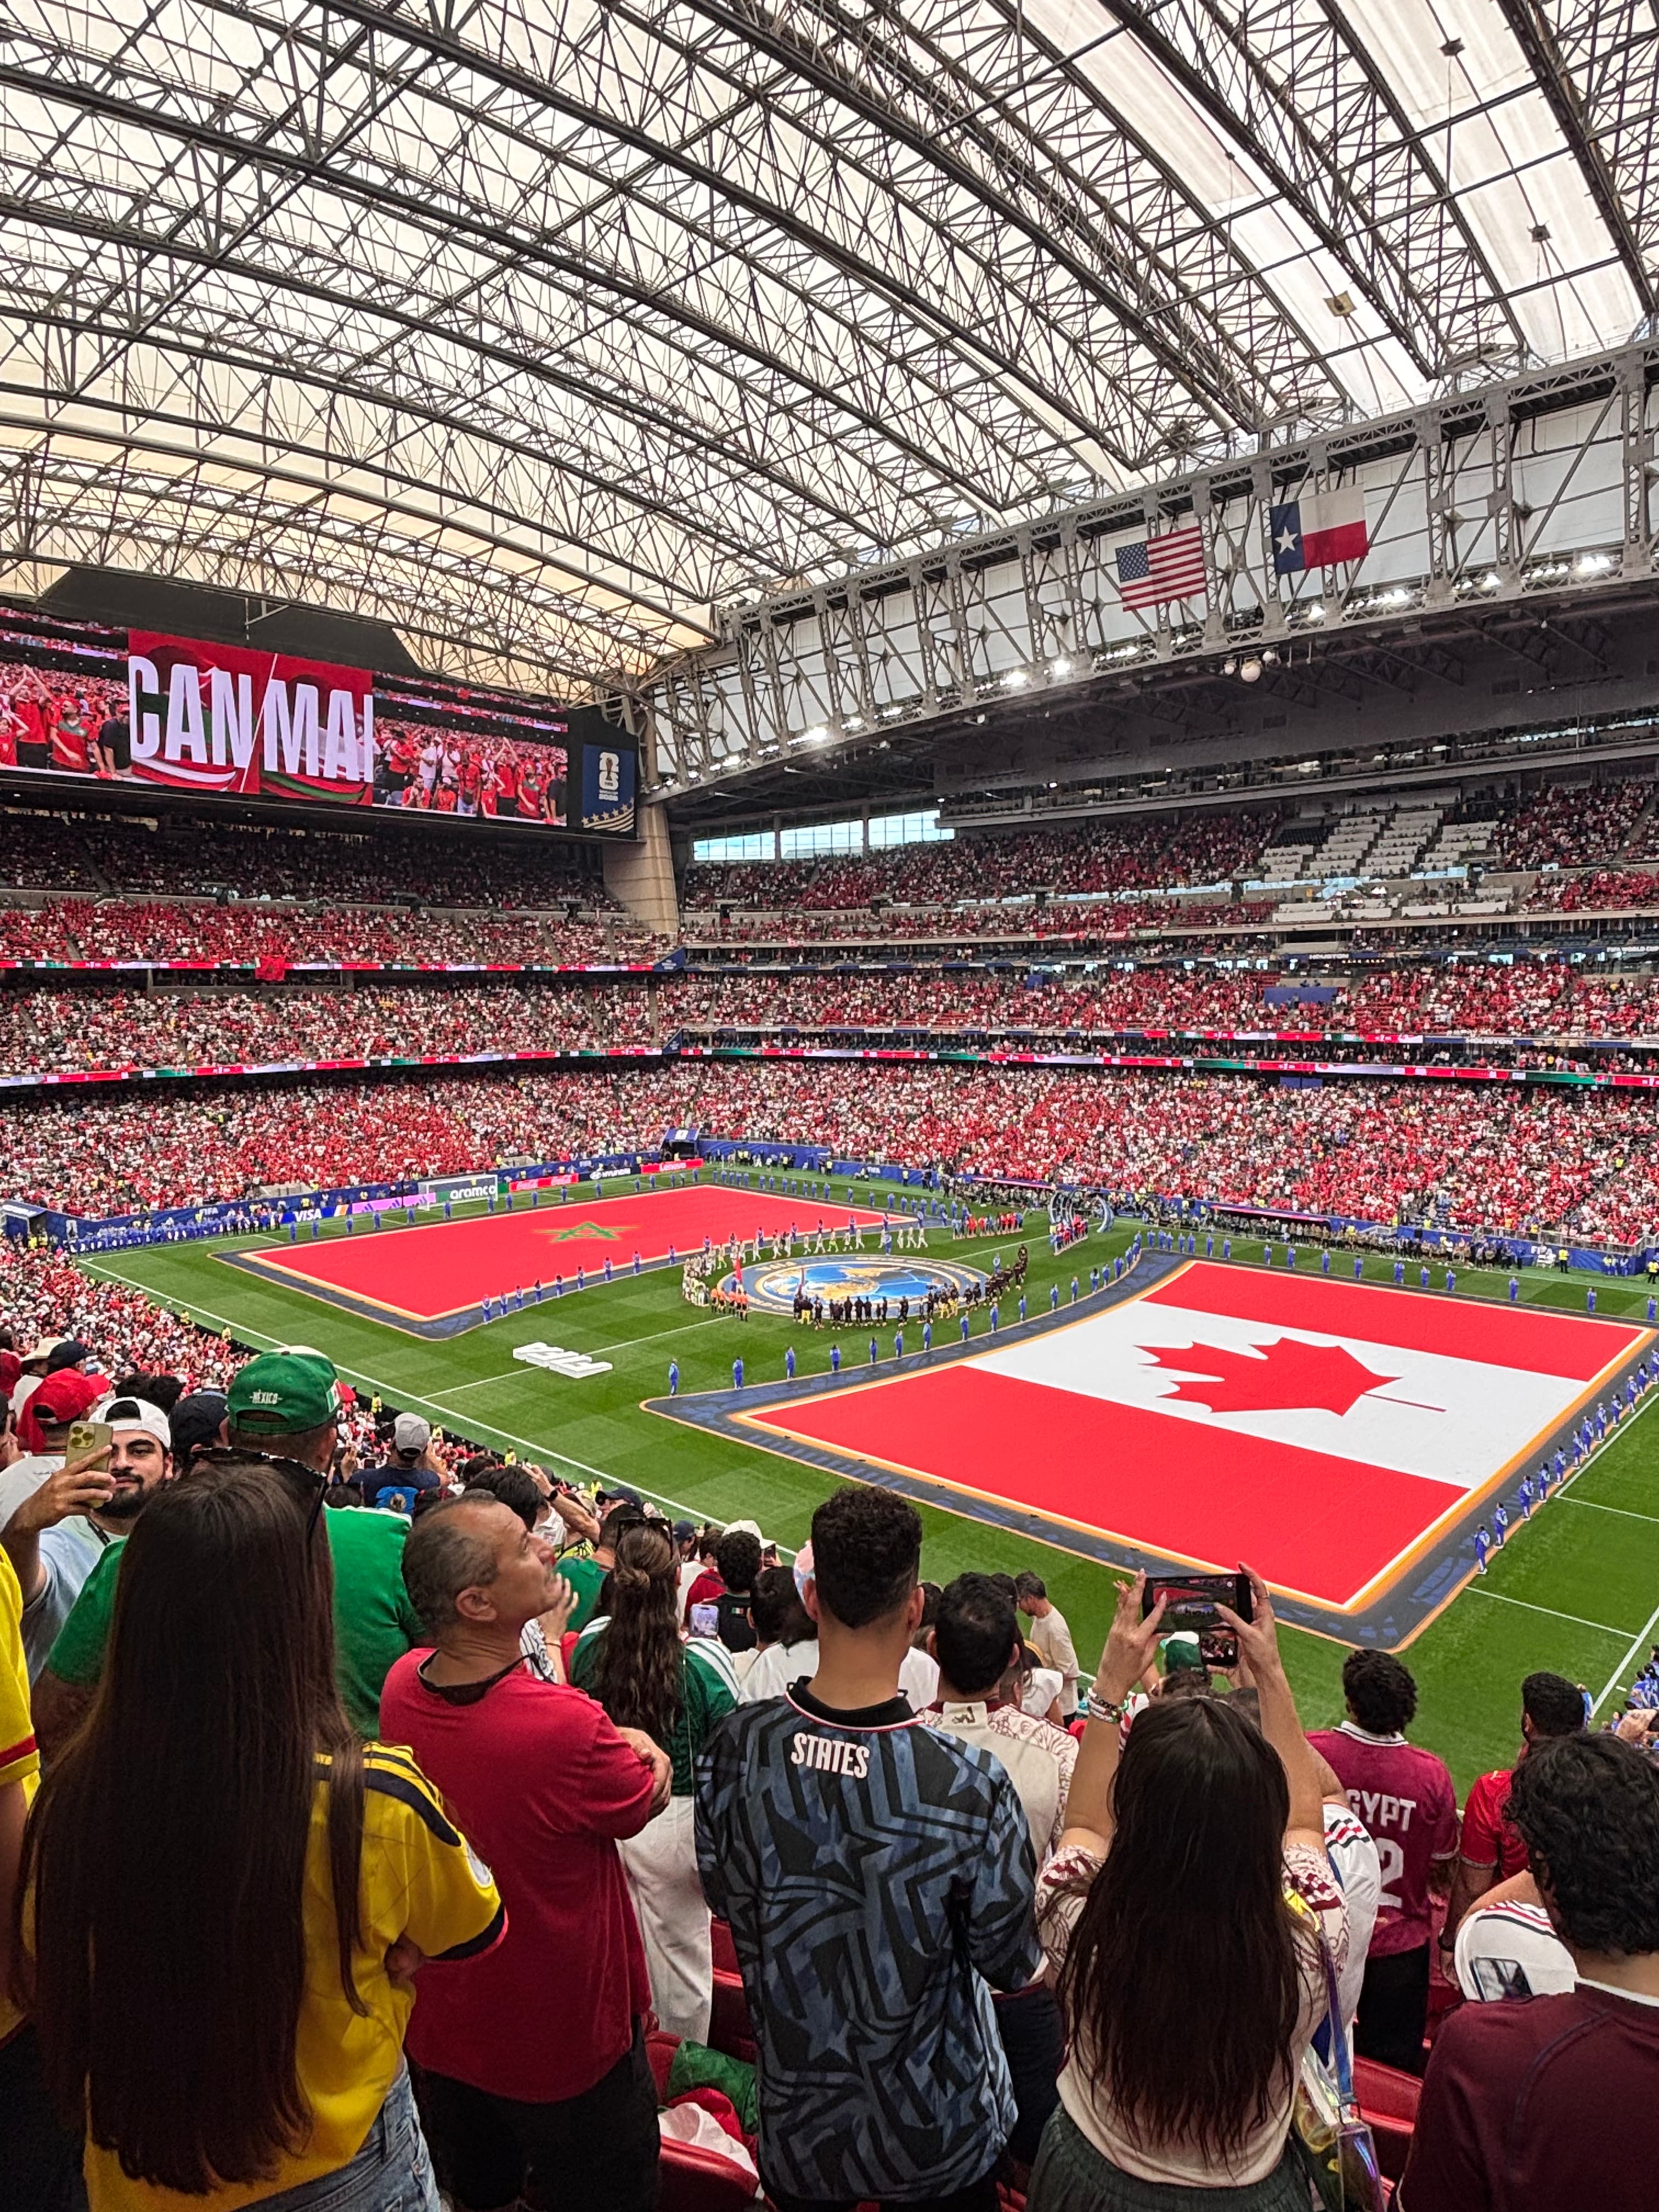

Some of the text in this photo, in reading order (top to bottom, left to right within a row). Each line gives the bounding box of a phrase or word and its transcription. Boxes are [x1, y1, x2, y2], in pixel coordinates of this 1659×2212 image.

[128, 656, 253, 769] CAN
[450, 1185, 496, 1199] aramco
[292, 1209, 322, 1222] VISA
[791, 1733, 870, 1779] STATES
[1346, 1788, 1417, 1832] GYPT
